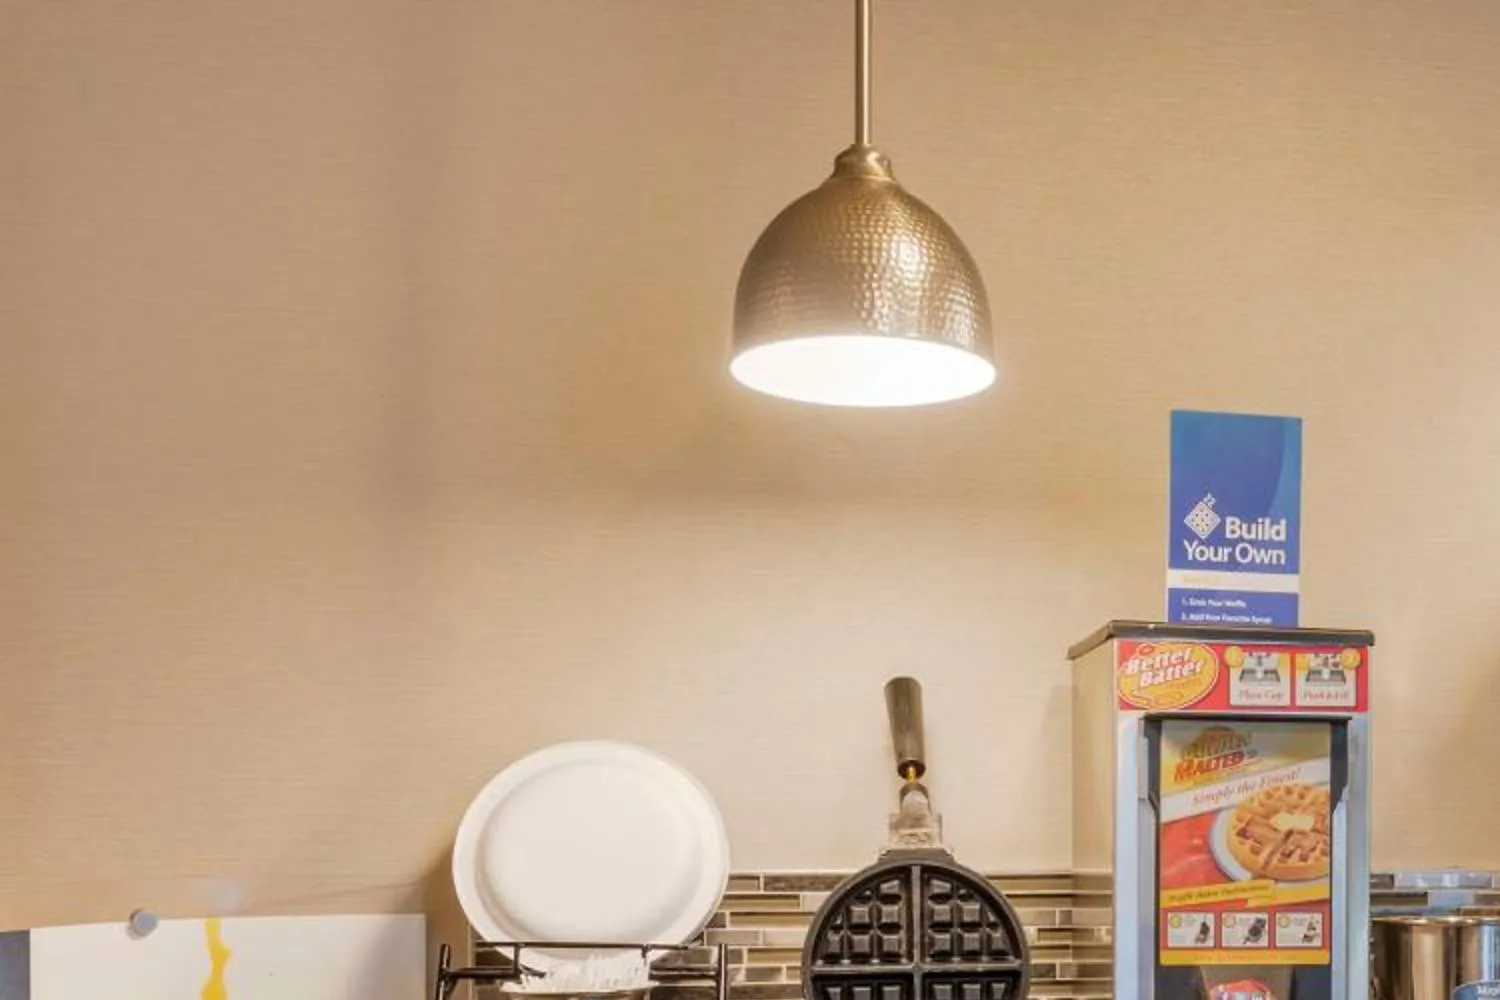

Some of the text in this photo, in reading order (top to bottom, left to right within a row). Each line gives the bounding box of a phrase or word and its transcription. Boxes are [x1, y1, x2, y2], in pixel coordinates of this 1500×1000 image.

[1225, 516, 1287, 541] Build
[1183, 539, 1286, 565] Your Own
[1125, 647, 1193, 675] Better
[1140, 661, 1204, 687] Batter
